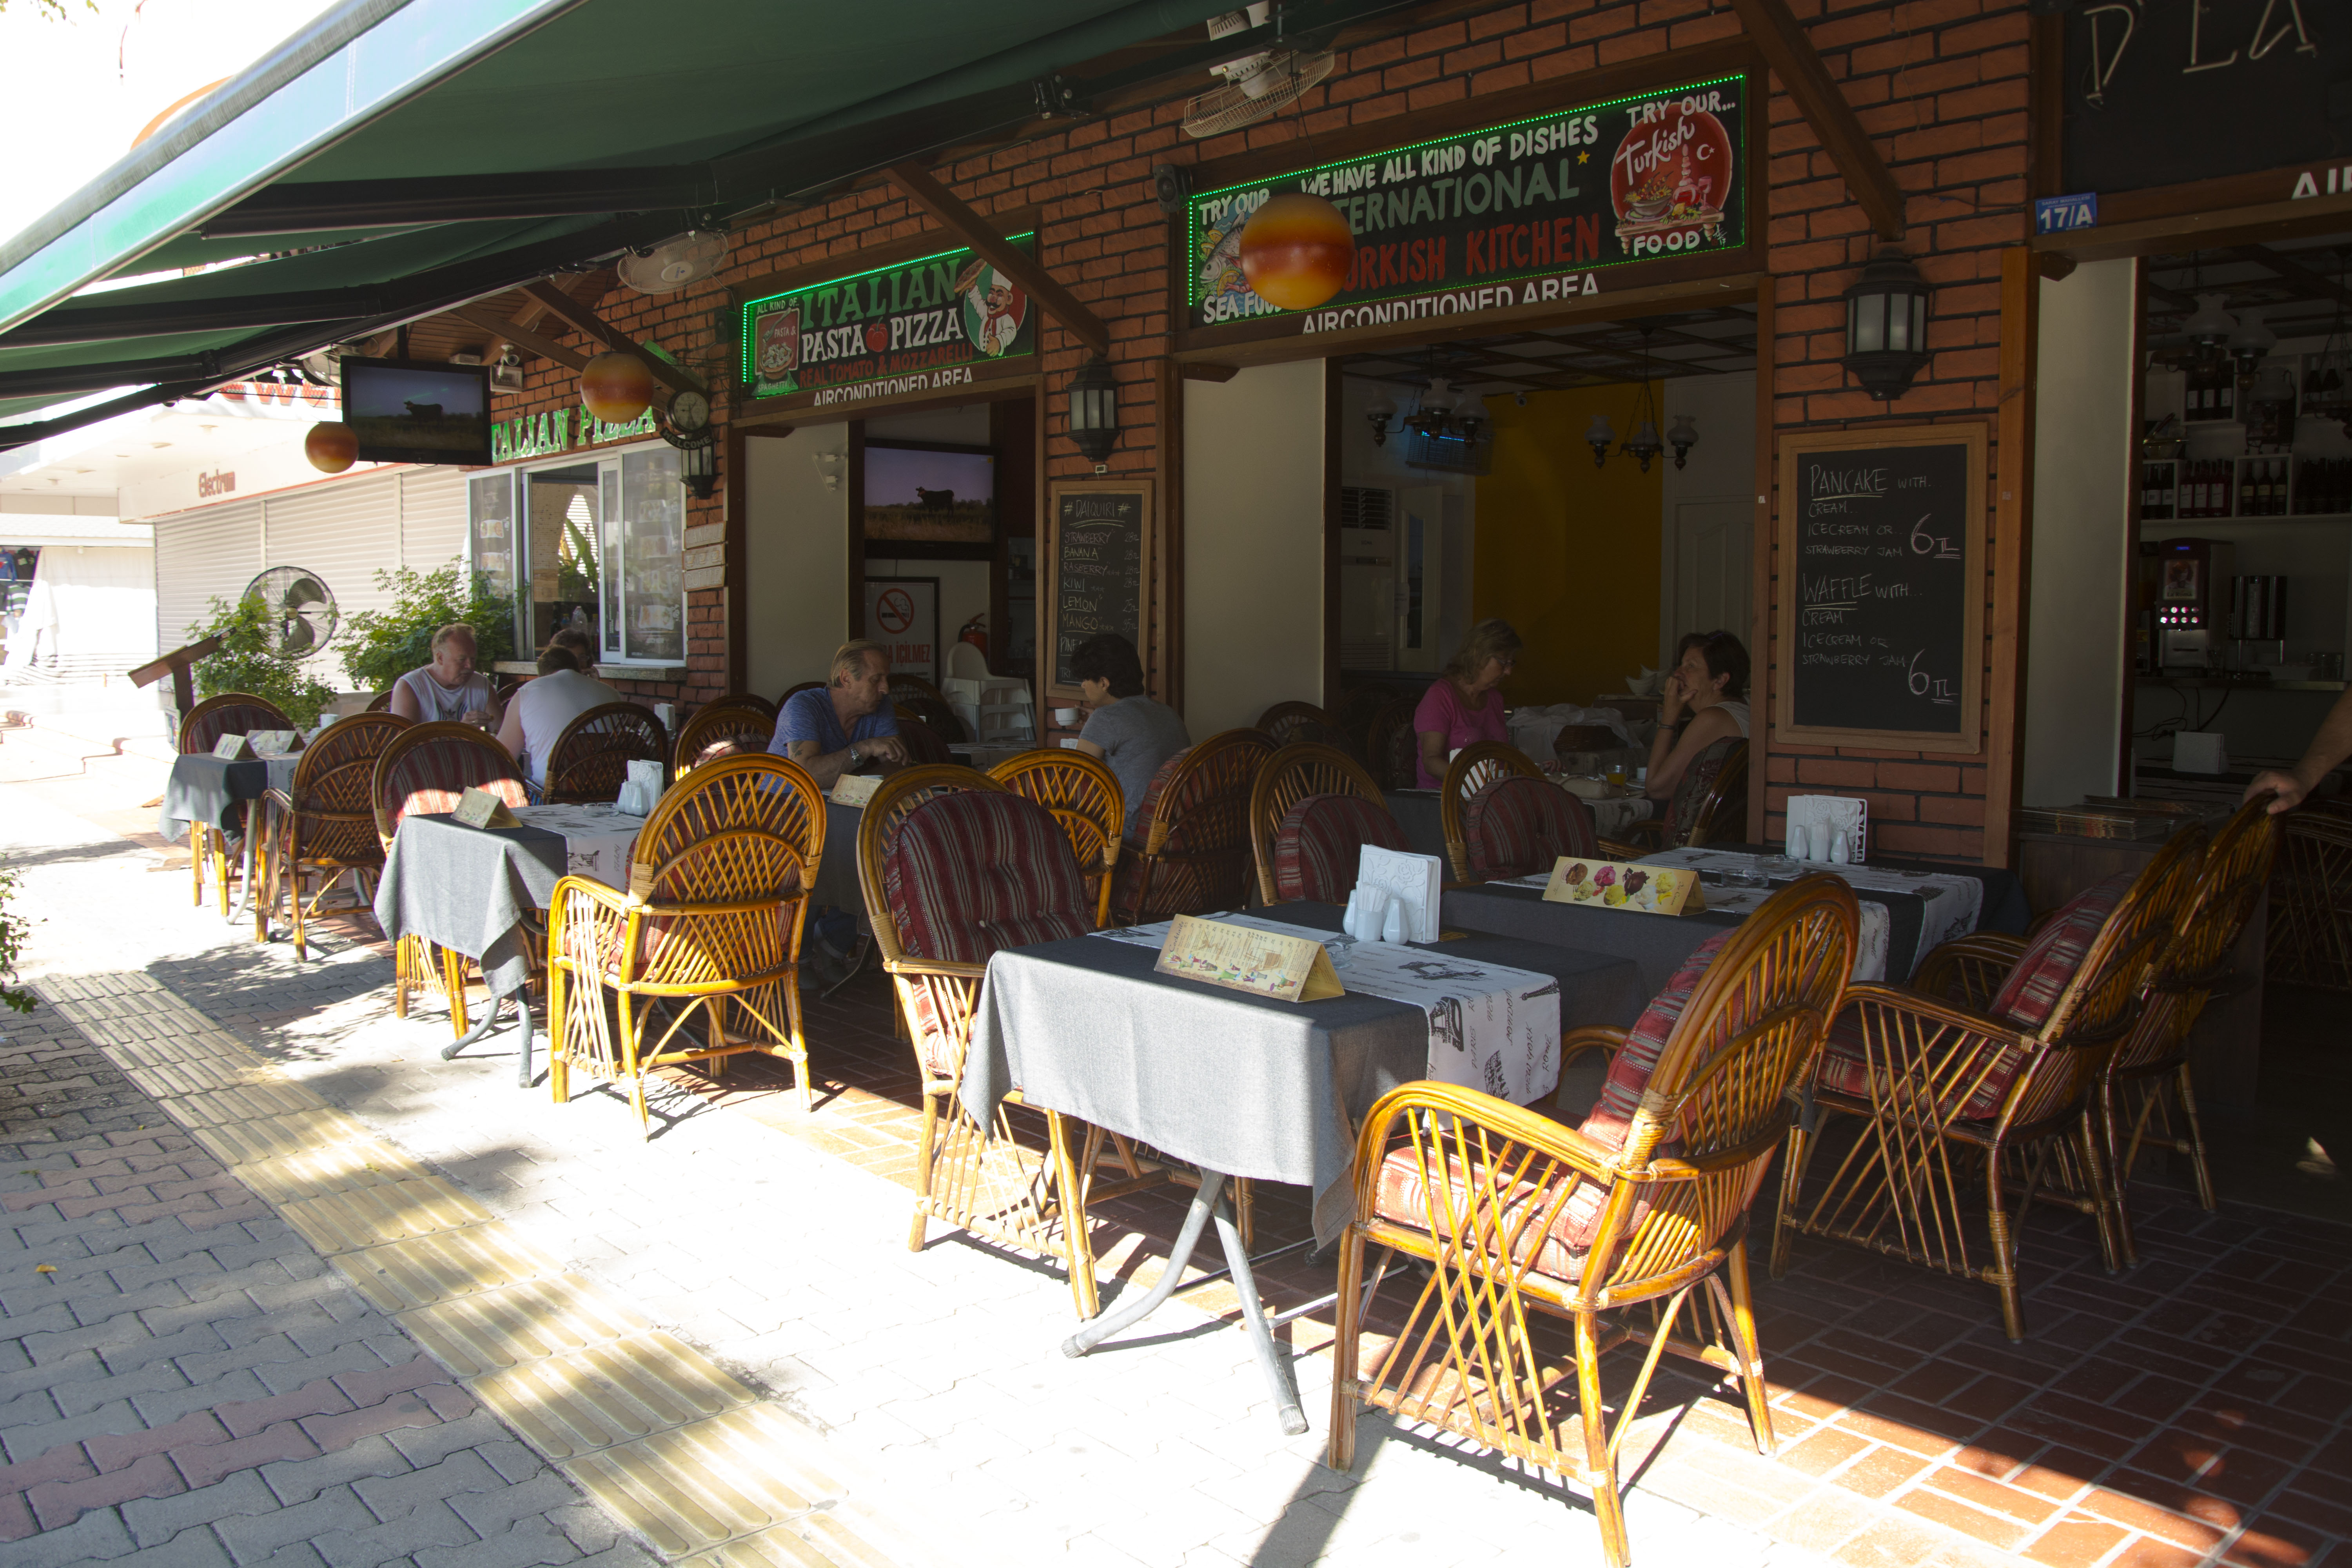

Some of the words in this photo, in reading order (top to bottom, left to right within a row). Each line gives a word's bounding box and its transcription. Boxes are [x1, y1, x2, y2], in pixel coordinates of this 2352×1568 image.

[1626, 100, 1670, 128] TRY
[1301, 172, 1330, 196] WE
[1333, 164, 1376, 194] HAVE
[1382, 154, 1416, 184] ALL
[1421, 145, 1465, 176] KIND
[1472, 136, 1502, 165] OF
[1510, 115, 1598, 161] DISHES
[1616, 116, 1695, 185] Turkish
[1198, 195, 1230, 225] TRY
[2041, 204, 2093, 229] 17/A
[1466, 213, 1599, 276] KITCHEN
[1634, 230, 1700, 256] FOOD
[757, 304, 768, 315] ALL
[770, 300, 786, 311] KIND
[801, 258, 960, 330] ITALIAN
[1203, 295, 1240, 323] SEA
[1303, 286, 1514, 334] AIRCONDITIONED
[1522, 273, 1599, 305] AREA
[774, 327, 789, 338] PASTA
[792, 326, 796, 336] &
[802, 324, 867, 363] PASTA
[890, 307, 964, 350] PIZZA
[758, 381, 787, 392] SPAGHETTI
[800, 366, 828, 388] REAL
[829, 359, 874, 383] TOMATO
[877, 355, 887, 376] &
[814, 375, 927, 407] AIRCONDITIONED
[932, 367, 972, 388] AREA
[662, 429, 712, 449] WELCOME
[1810, 464, 1888, 497] PANCAKE
[1076, 500, 1114, 517] DAIQUIRI
[1808, 523, 1869, 537] ICECREAM
[1911, 513, 1935, 555] 6
[1805, 545, 1870, 556] STRAWBERRY
[1877, 546, 1902, 557] JAM
[1804, 573, 1873, 602] WAFFLE
[1804, 632, 1862, 648] ICECREAM
[1802, 653, 1871, 666] STRAWBERRY
[1879, 655, 1906, 667] JAM
[1908, 649, 1929, 695] 6
[1169, 921, 1184, 952] Cocktails
[1503, 988, 1513, 1046] LONDON
[1526, 1022, 1534, 1061] YORK
[1542, 1033, 1552, 1072] ROME
